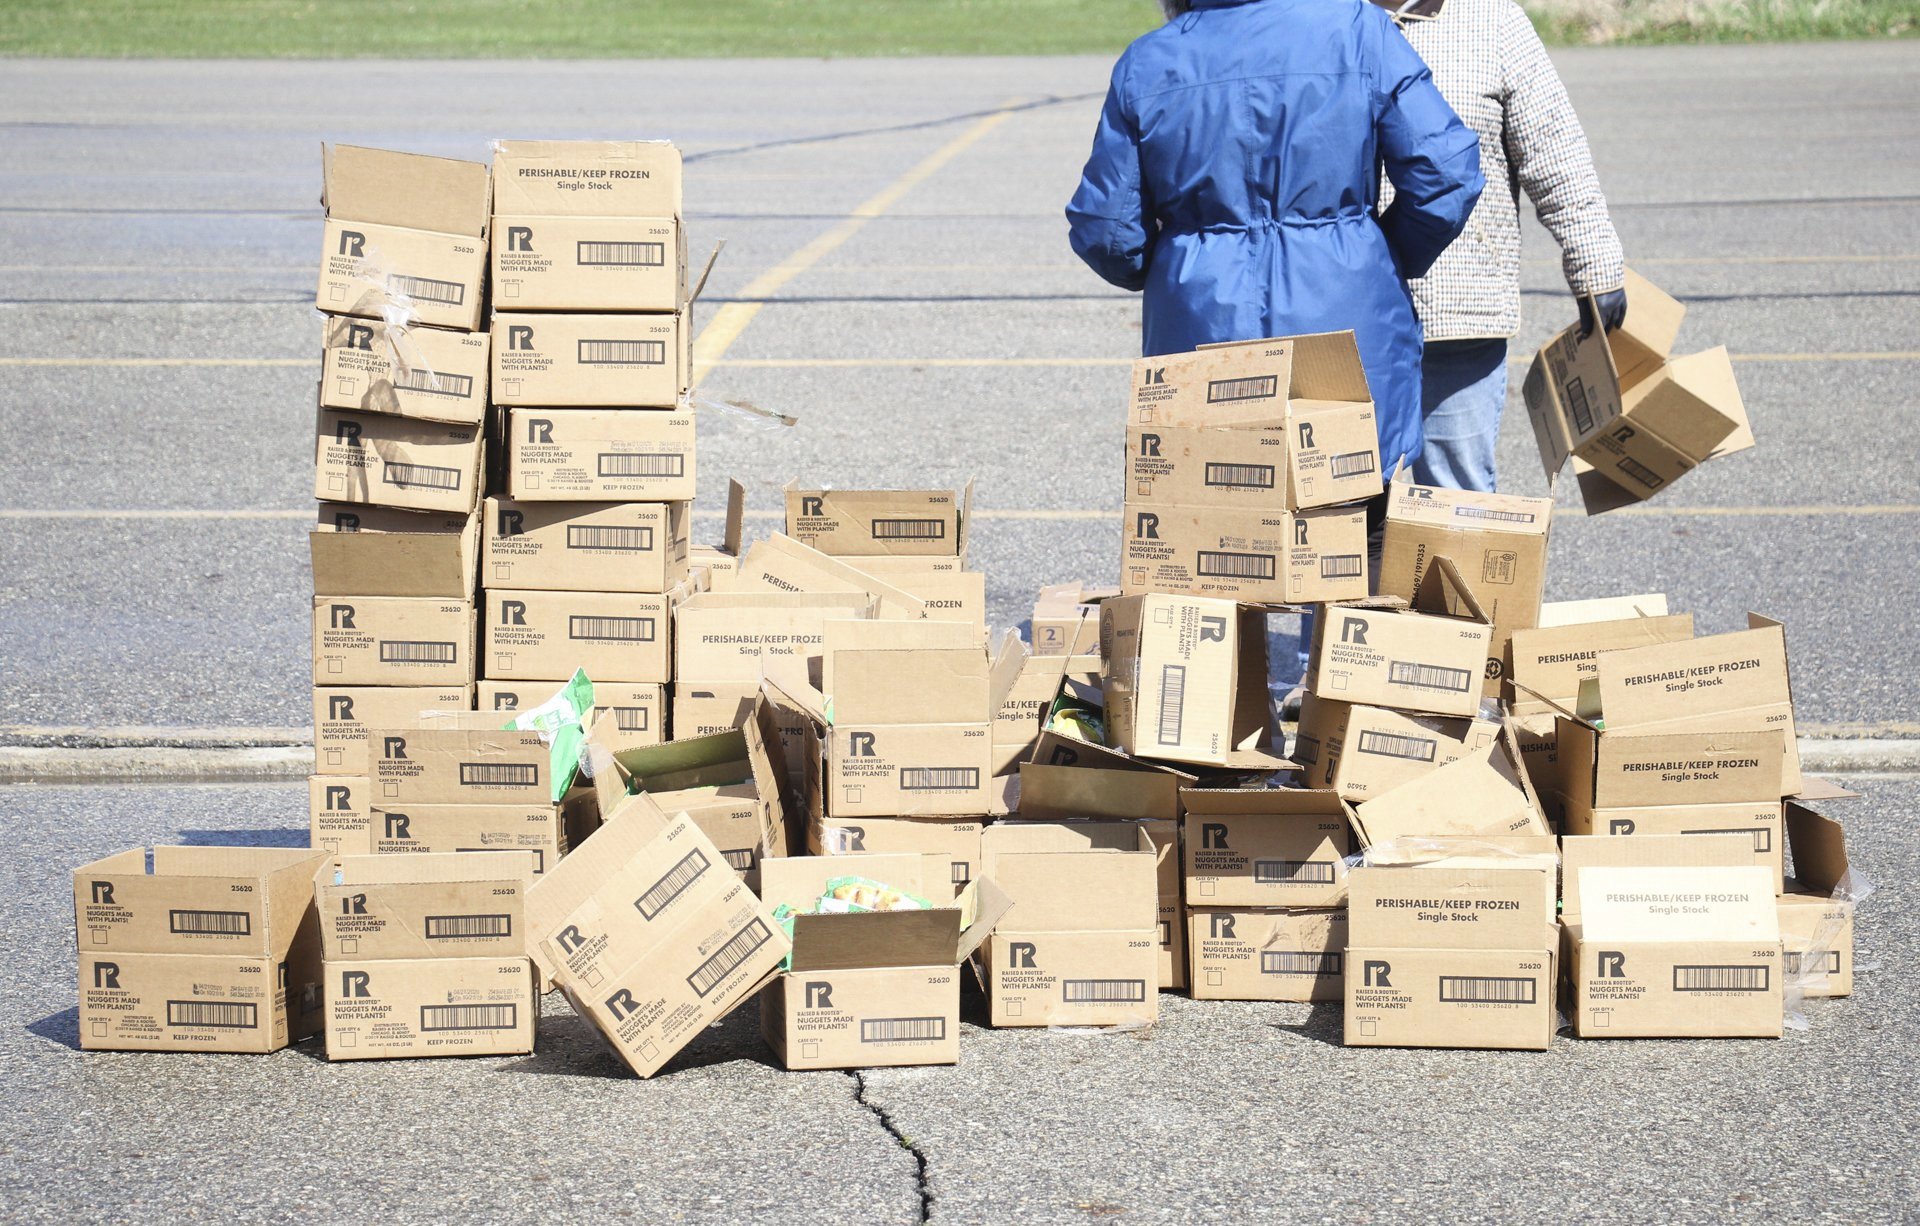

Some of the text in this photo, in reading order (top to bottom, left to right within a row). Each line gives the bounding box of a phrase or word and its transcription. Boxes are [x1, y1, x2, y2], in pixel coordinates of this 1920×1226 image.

[519, 168, 650, 179] PERISHABLE/KEEP FROZEN
[557, 181, 612, 191] Single Stock
[461, 338, 482, 347] 25620
[1265, 349, 1284, 357] 25620
[1261, 438, 1280, 446] 25620
[1129, 546, 1155, 554] NUGGETS
[925, 600, 962, 608] FROZEN
[1046, 629, 1056, 641] 2
[1178, 606, 1188, 654] WITH PLANTS!
[1184, 606, 1194, 661] NUGGETS MADE
[1460, 631, 1481, 639] 25620
[702, 635, 822, 644] PERISHABLE/KEEP FROZE
[739, 646, 794, 657] Singl Stock
[1331, 649, 1385, 662] NUGGETS MADE
[1331, 655, 1379, 667] WITH PLANTS!
[1576, 663, 1597, 672] Sing
[1624, 659, 1761, 687] PERISHABLE/KEEP FROZEN
[1665, 676, 1723, 692] Single Stock
[1766, 714, 1787, 723] 25620
[520, 738, 543, 746] 25620
[1623, 759, 1758, 772] PERISHABLE/KEEP FROZEN
[1661, 771, 1719, 783] Single Stock
[1509, 818, 1530, 831] 25620
[667, 823, 686, 842] 25620
[723, 885, 741, 903] 25620
[1606, 894, 1749, 903] PERISHABLE/KEEP FROZEN
[1376, 898, 1519, 910] PERISHABLE/KEEP FROZEN
[1649, 905, 1709, 915] Single Stock
[1417, 912, 1478, 923] Single Stock
[711, 971, 749, 1006] KEEP FROZEN
[619, 1012, 649, 1039] NUGGETS
[648, 997, 667, 1015] MADE
[623, 1028, 642, 1044] WITH
[640, 1007, 666, 1030] PLANTS!
